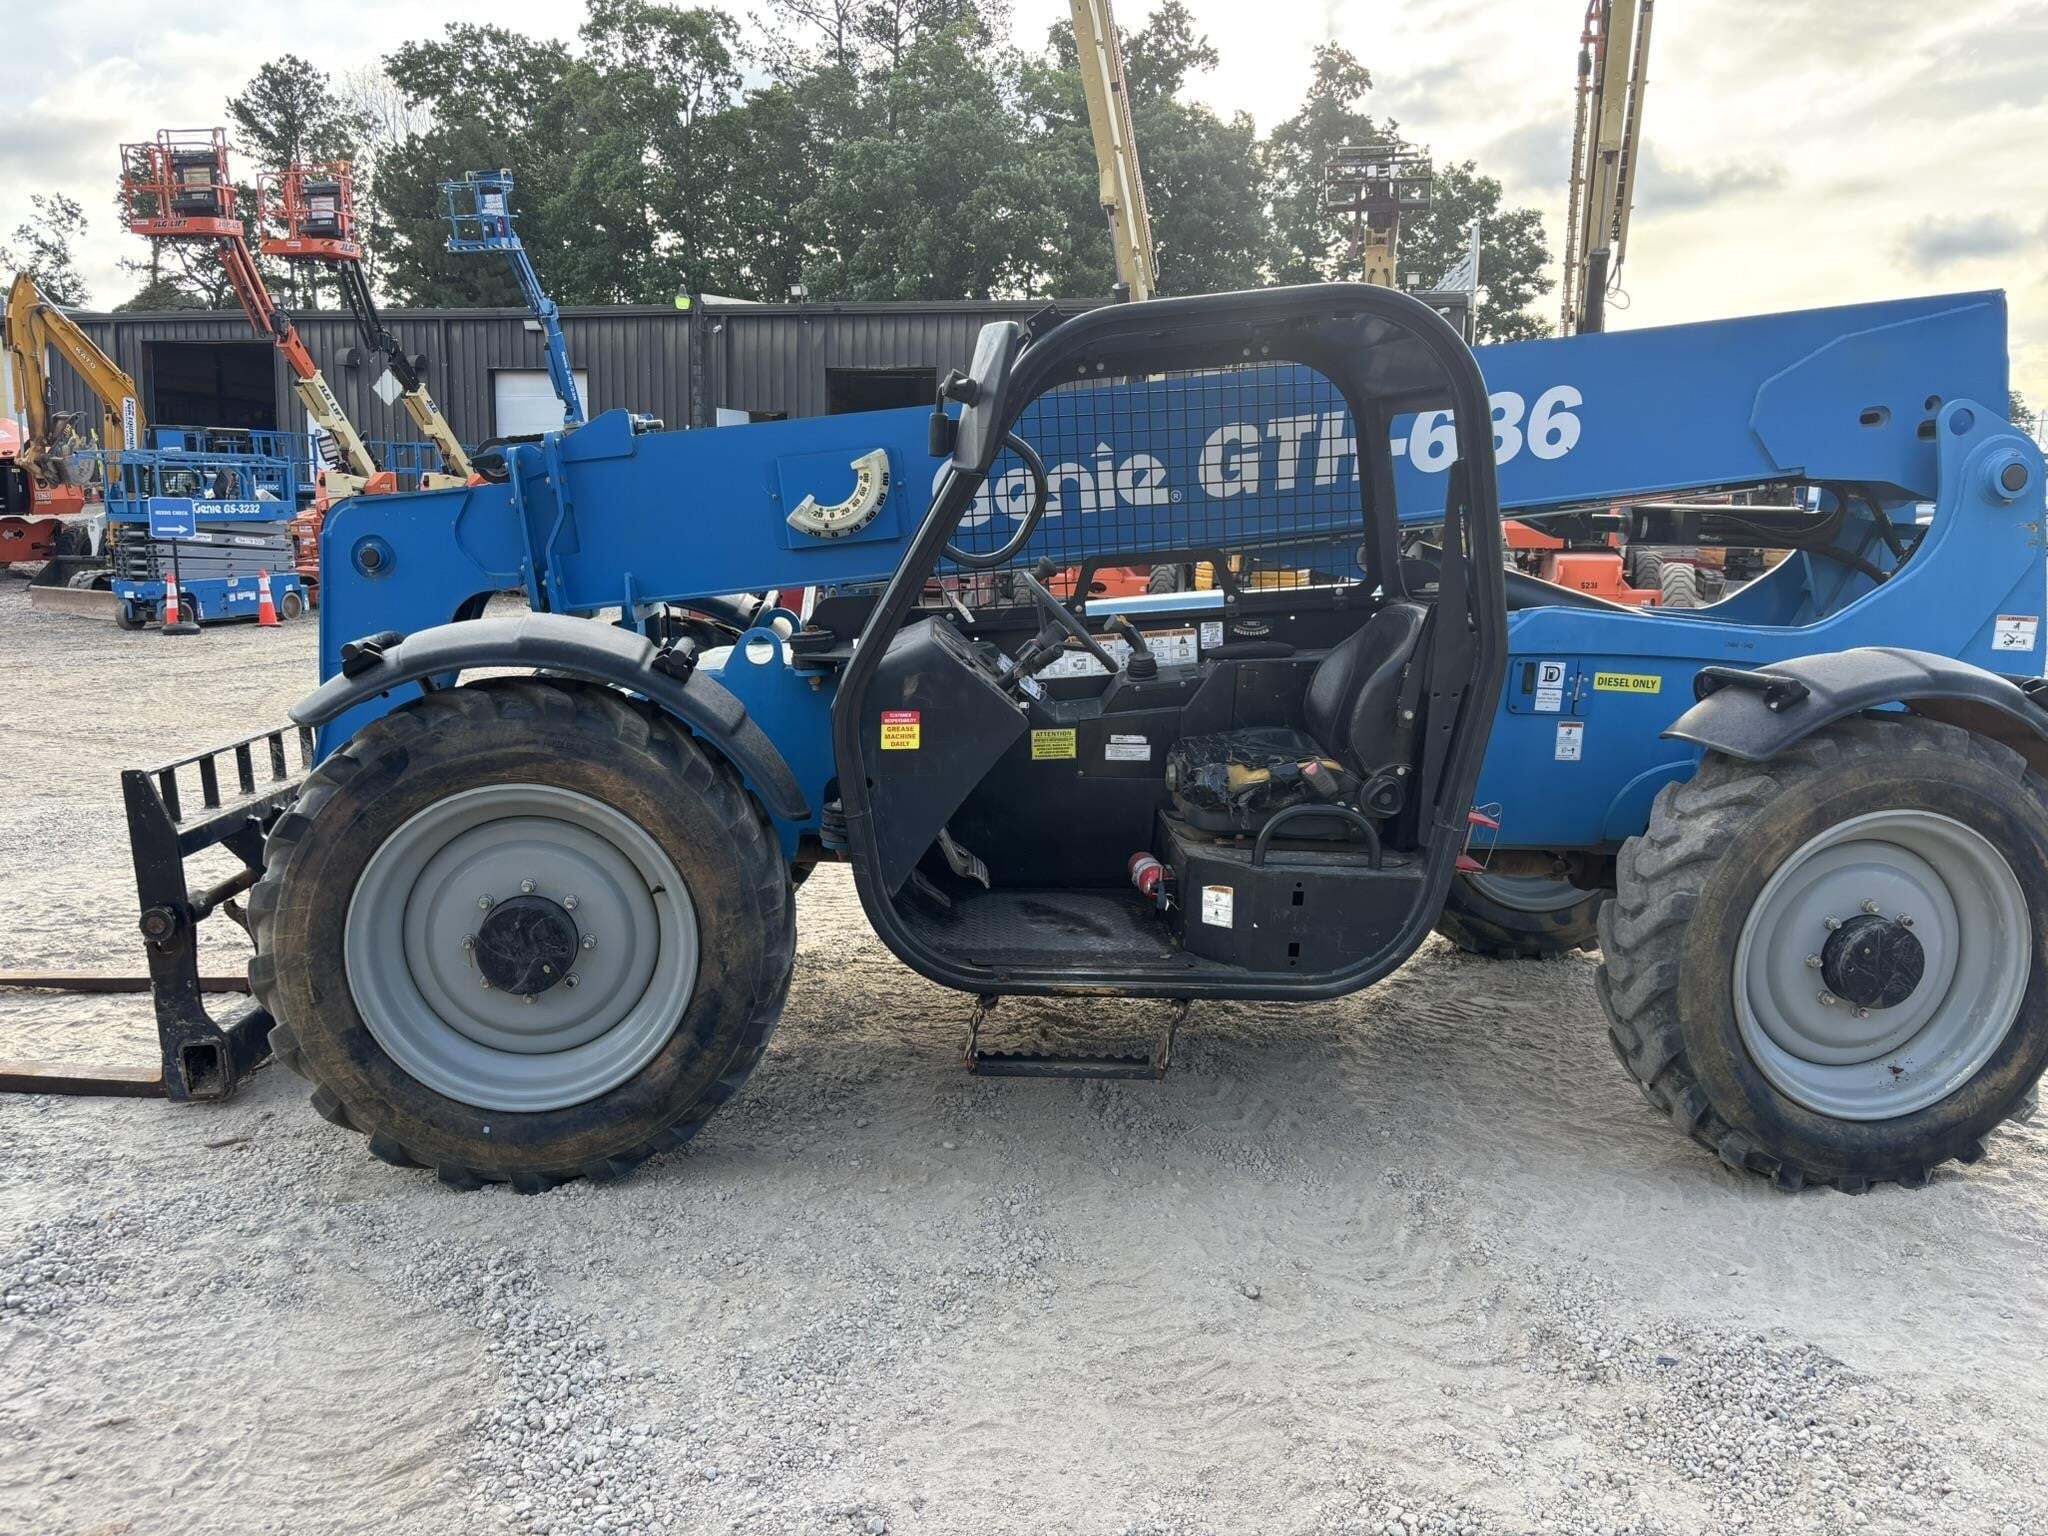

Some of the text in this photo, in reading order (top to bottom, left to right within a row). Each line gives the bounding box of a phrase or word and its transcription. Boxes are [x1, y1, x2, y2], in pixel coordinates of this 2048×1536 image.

[153, 220, 168, 228] JLG
[169, 219, 188, 227] LIFT
[339, 243, 356, 252] JLG
[319, 384, 345, 422] JLG LIFT
[427, 400, 439, 413] JLG
[1199, 385, 1584, 498] GTH-636
[192, 502, 260, 514] Genie GS-3232
[1543, 665, 1561, 682] D
[1597, 676, 1657, 689] DIESEL ONLY
